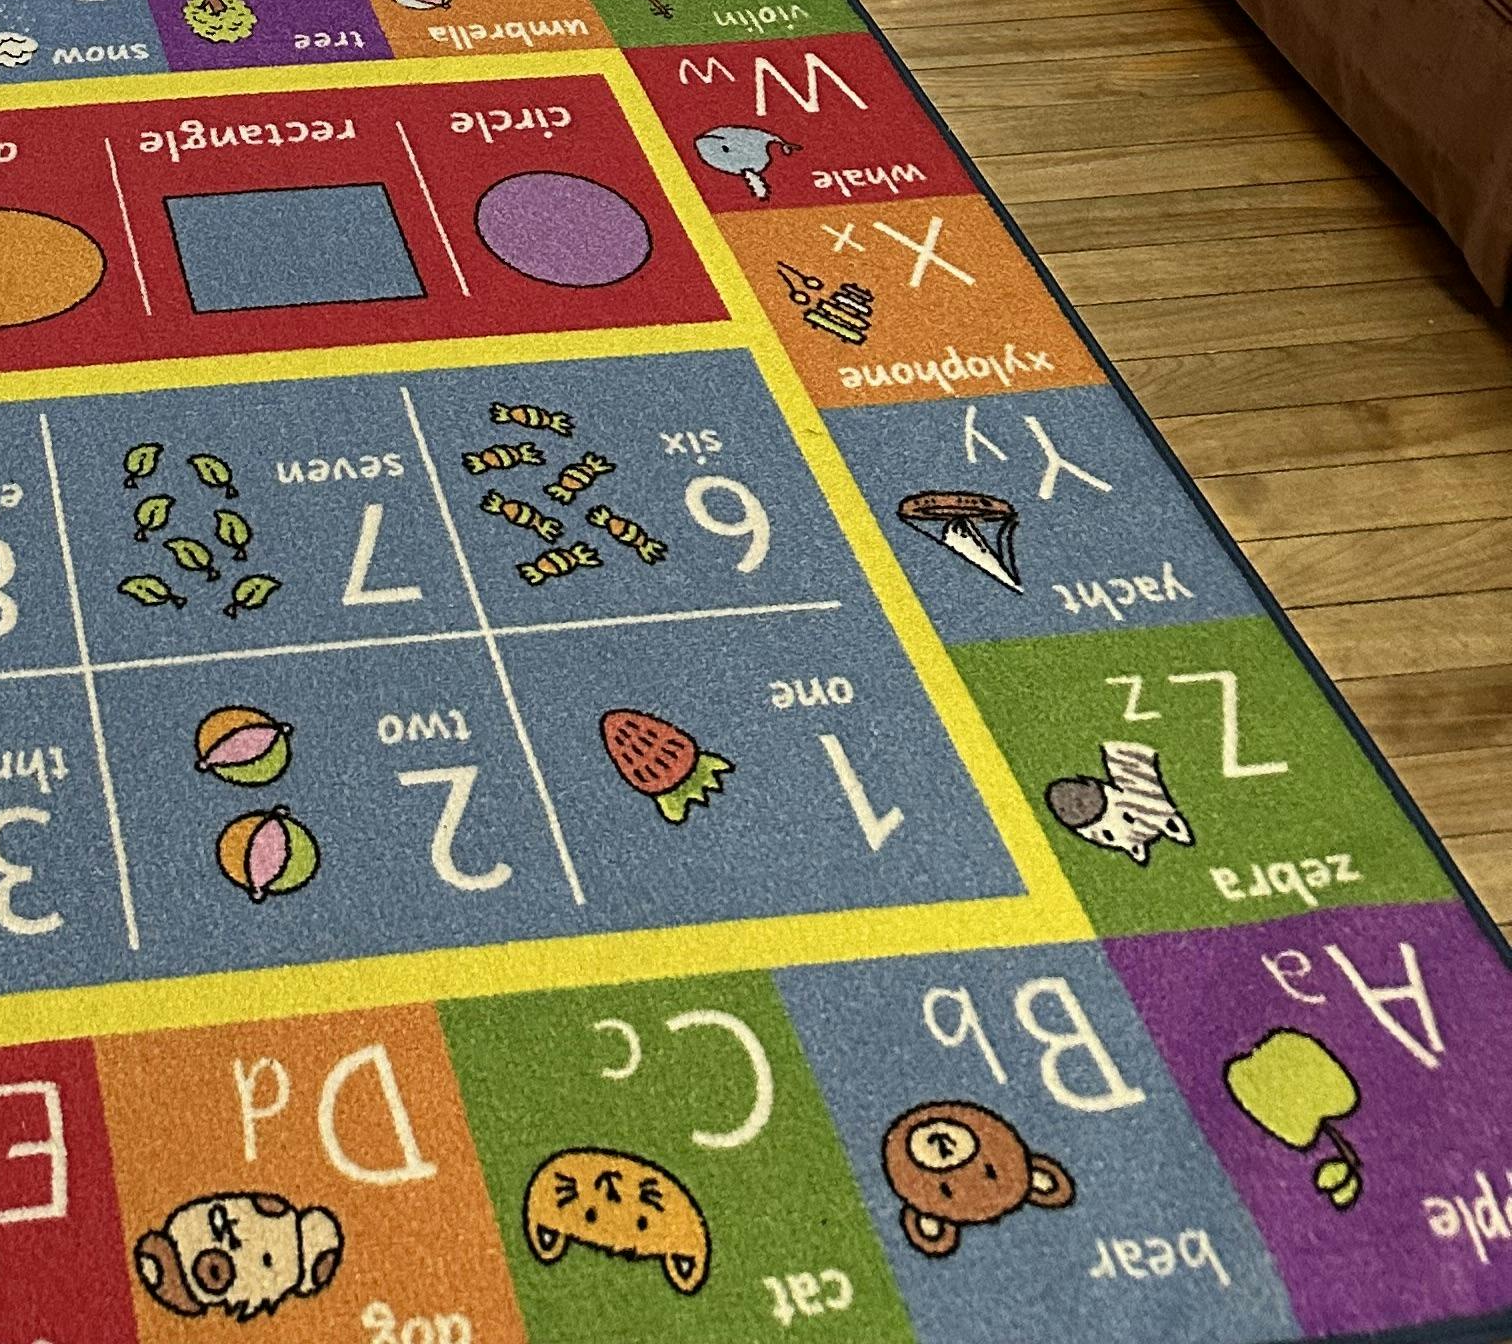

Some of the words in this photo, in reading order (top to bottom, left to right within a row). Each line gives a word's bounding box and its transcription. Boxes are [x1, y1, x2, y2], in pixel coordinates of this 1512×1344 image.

[428, 19, 588, 50] umbrella
[714, 5, 808, 33] violin
[52, 44, 149, 64] snow
[295, 31, 364, 49] tree
[140, 120, 355, 162] rectangle
[451, 107, 571, 143] circle
[812, 164, 926, 197] whale
[839, 343, 1056, 399] xylophone
[660, 429, 722, 465] six
[277, 453, 404, 483] seven
[684, 476, 770, 573] 6
[342, 504, 423, 606] 7
[1052, 562, 1194, 621] yacht
[769, 677, 853, 709] one
[377, 709, 471, 745] two
[819, 734, 904, 852] 1
[398, 766, 512, 891] 2
[1210, 854, 1361, 906] zebra
[1089, 1229, 1231, 1287] bear
[763, 1269, 853, 1326] cat
